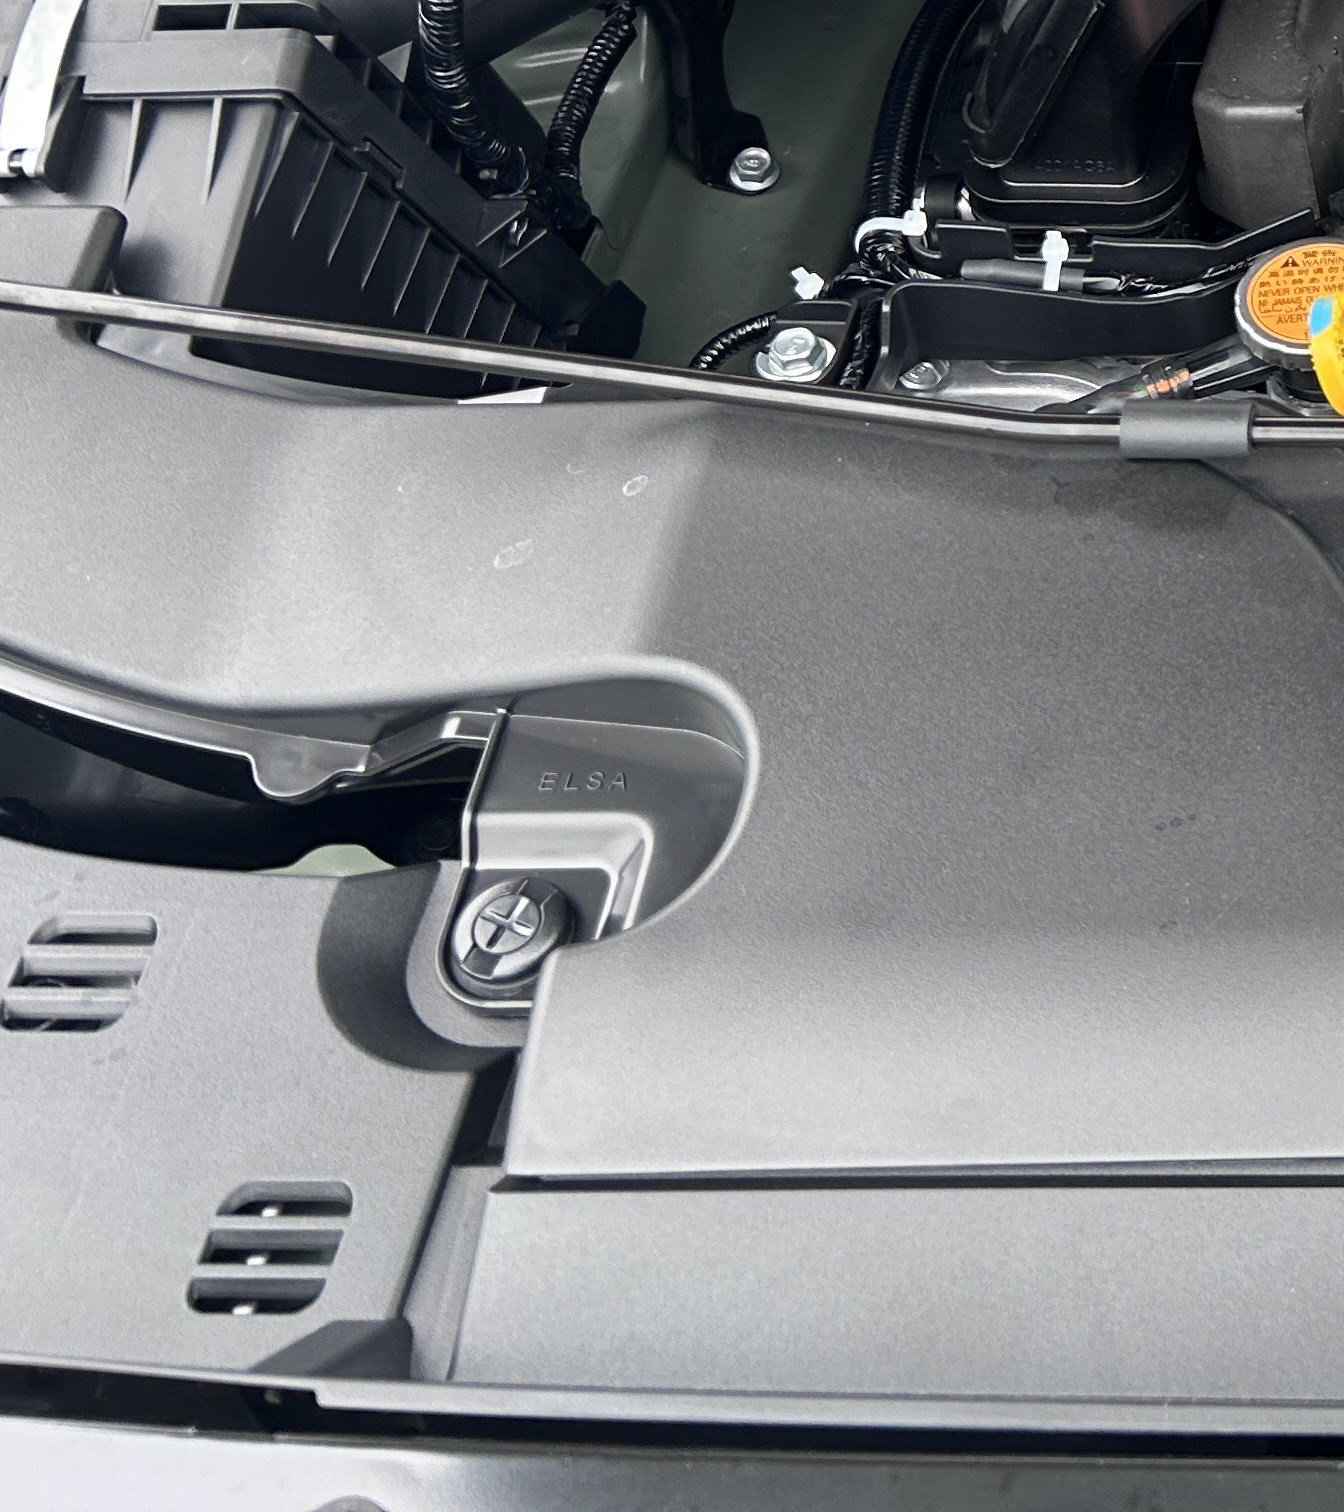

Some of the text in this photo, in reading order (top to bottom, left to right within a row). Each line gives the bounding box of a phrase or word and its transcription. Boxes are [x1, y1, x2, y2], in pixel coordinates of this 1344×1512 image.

[1259, 288, 1290, 298] NEVER
[1294, 286, 1320, 295] OPEN
[1272, 296, 1302, 306] JAMAIS
[539, 772, 626, 791] ELSA
